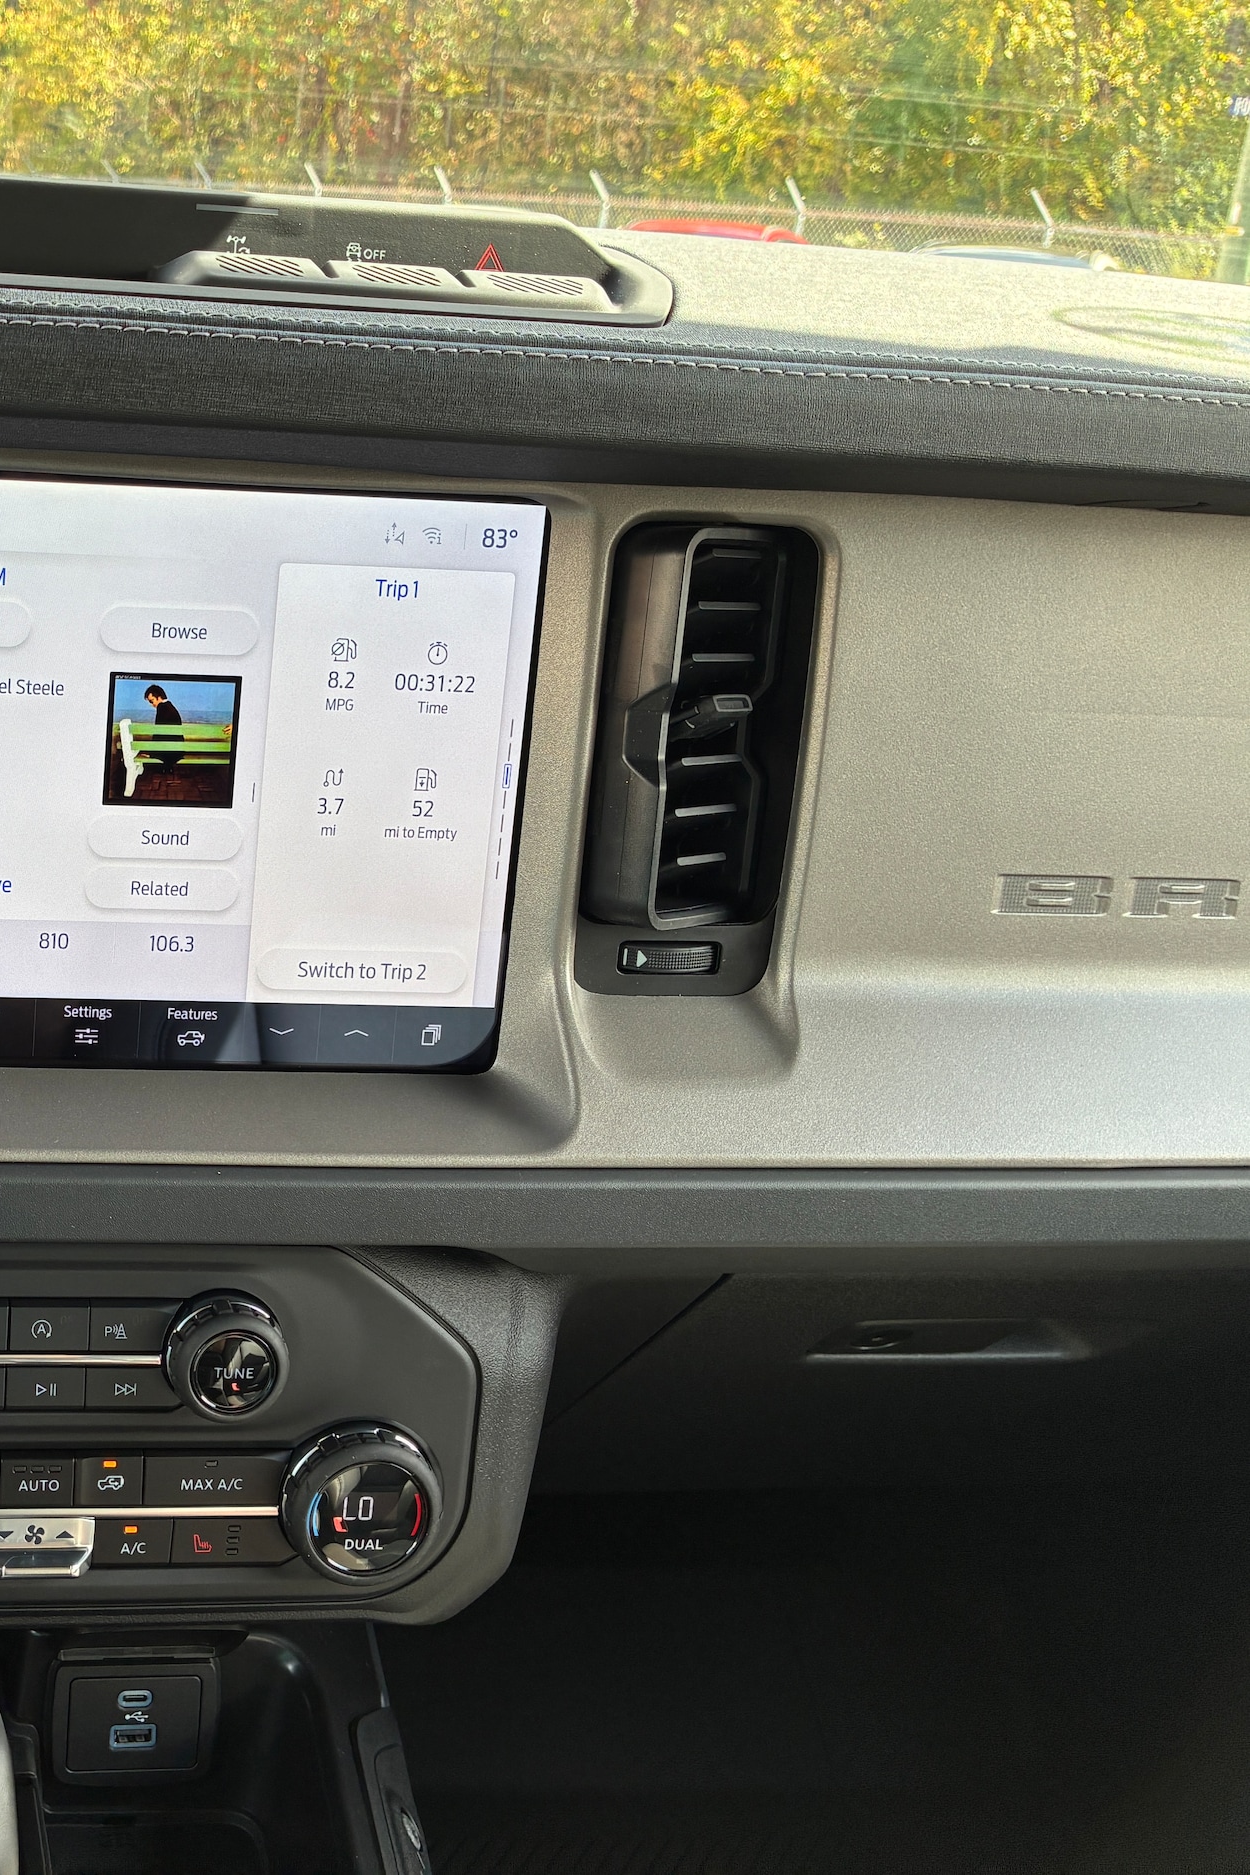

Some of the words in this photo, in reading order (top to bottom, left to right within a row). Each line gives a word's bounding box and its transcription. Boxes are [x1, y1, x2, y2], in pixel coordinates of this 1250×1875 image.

[363, 248, 386, 260] OFF
[482, 528, 518, 548] 83°
[376, 578, 408, 601] Trip
[413, 580, 419, 598] 1
[151, 622, 208, 641] Browse
[16, 678, 65, 697] Steele
[328, 671, 355, 689] 8.2
[395, 674, 475, 693] 00:31:22
[325, 699, 354, 712] MPG
[418, 701, 448, 715] Time
[317, 798, 344, 816] 3.7
[412, 801, 434, 818] 52
[141, 829, 190, 847] Sound
[321, 824, 336, 837] mi
[384, 826, 399, 838] mi
[403, 827, 415, 839] to
[418, 826, 457, 842] Empty
[130, 880, 189, 898] Related
[39, 933, 69, 951] 810
[150, 935, 194, 953] 106.3
[298, 961, 355, 979] Switch
[359, 963, 376, 980] to
[381, 963, 413, 983] Trip
[416, 964, 426, 981] 2
[64, 1005, 112, 1021] Settings
[167, 1006, 218, 1021] Features
[214, 1367, 254, 1380] TUNE
[18, 1479, 60, 1492] AUTO
[181, 1478, 214, 1491] MAX
[217, 1478, 243, 1492] A/C
[342, 1496, 374, 1522] LO
[120, 1541, 146, 1555] A/C
[345, 1538, 384, 1551] DUAL
